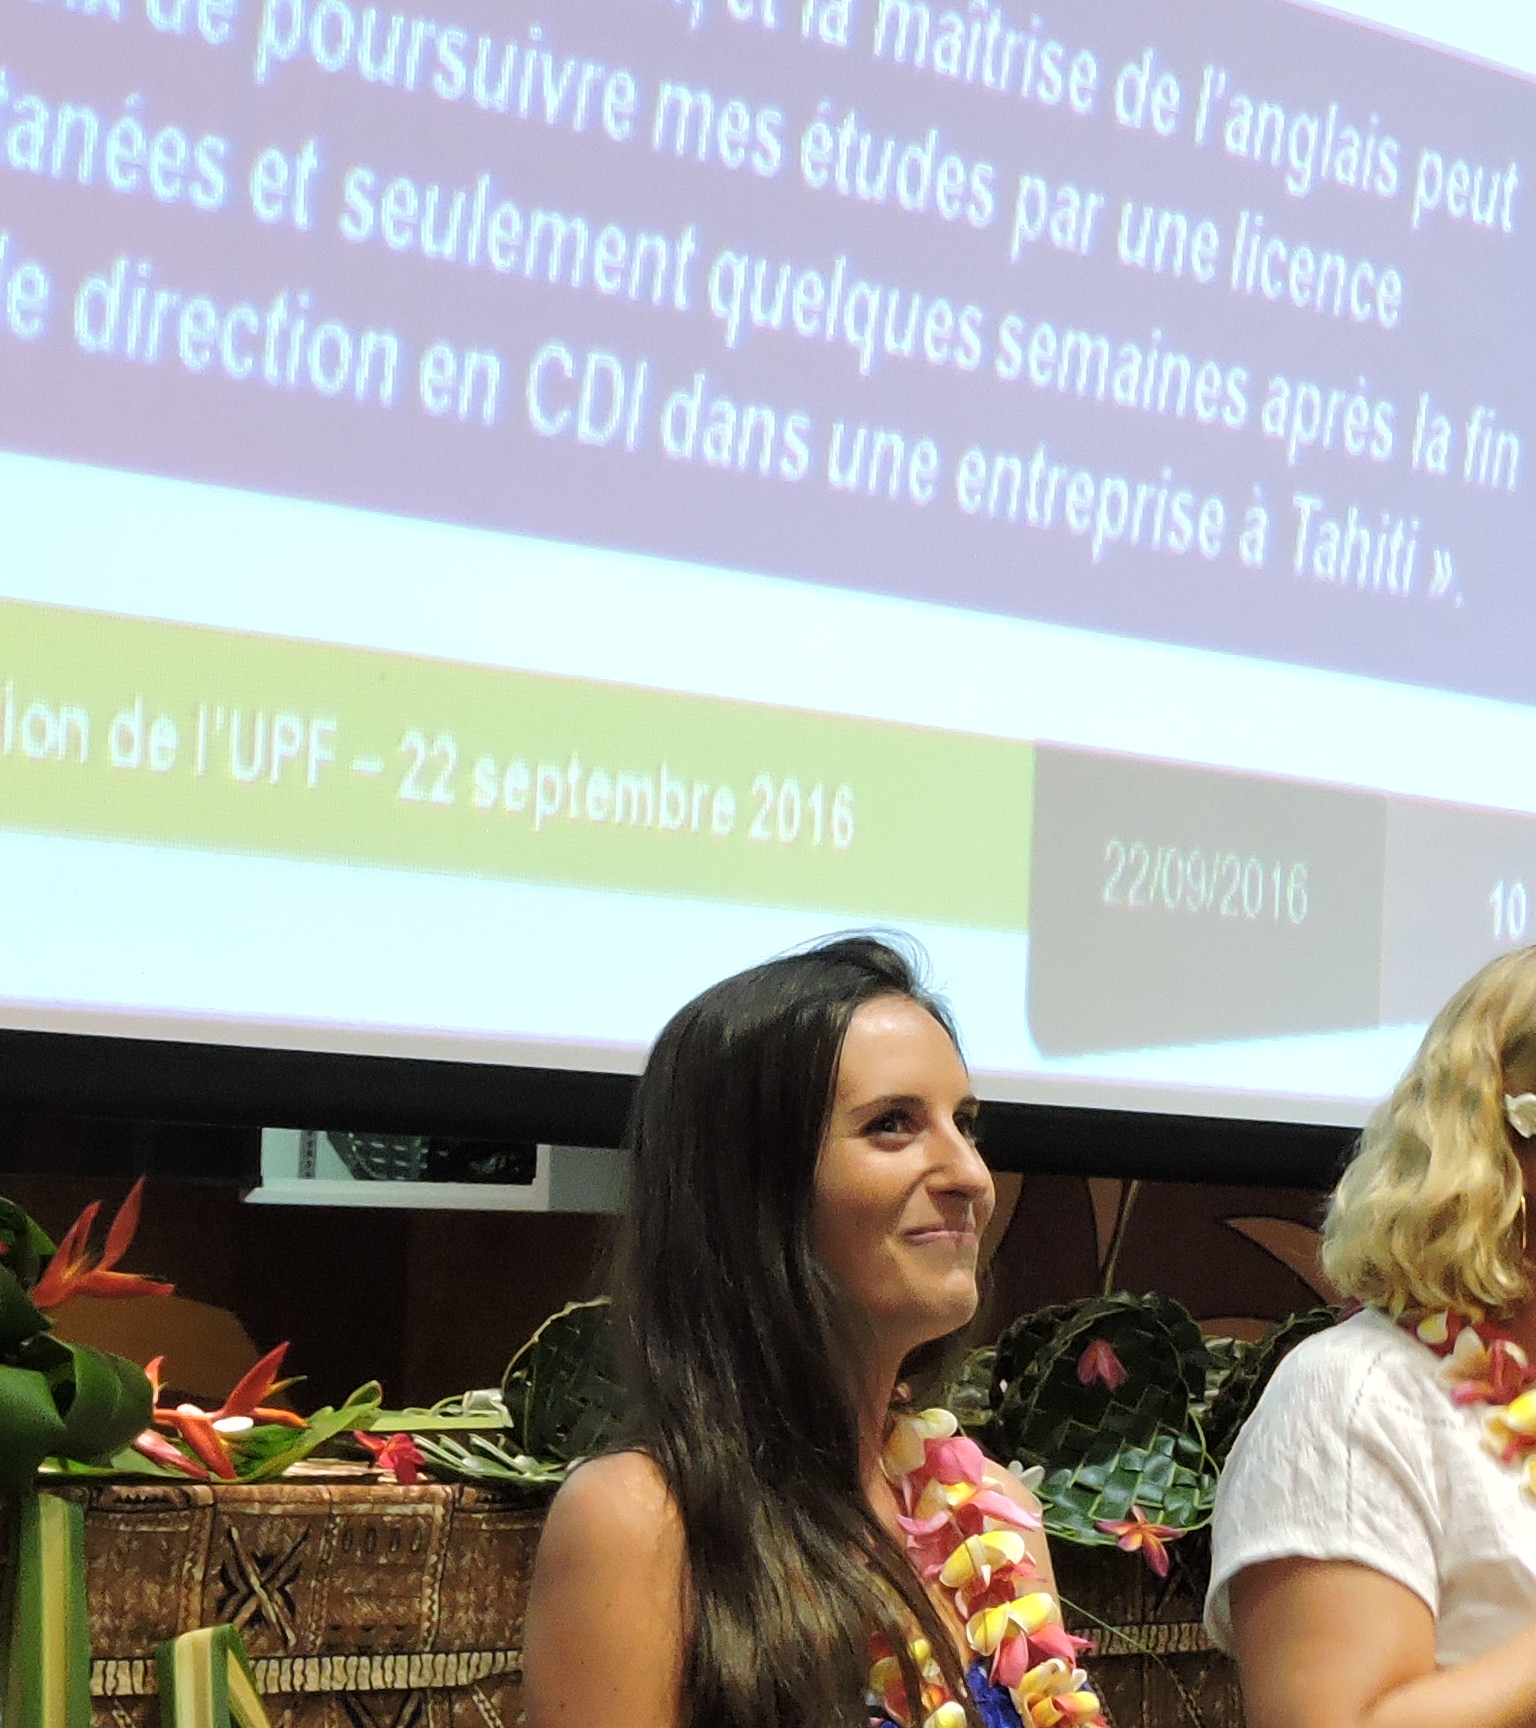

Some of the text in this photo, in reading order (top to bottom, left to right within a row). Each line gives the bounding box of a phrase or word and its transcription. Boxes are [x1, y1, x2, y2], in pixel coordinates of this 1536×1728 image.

[252, 0, 637, 140] poursuivre
[652, 80, 782, 176] mes
[800, 98, 996, 228] études
[1010, 174, 1106, 262] par
[1117, 202, 1221, 284] une
[1230, 210, 1404, 328] licence
[873, 0, 1098, 114] maîtrise
[1114, 46, 1181, 135] de
[1195, 64, 1400, 197] l'anglais
[1412, 148, 1519, 232] peut
[74, 255, 400, 406] direction
[419, 340, 502, 425] en
[526, 340, 648, 452] CDI
[661, 372, 810, 480] dans
[828, 420, 940, 504] une
[954, 443, 1227, 564] entreprise
[1237, 484, 1270, 568] à
[1293, 493, 1419, 597] Tahiti
[250, 137, 318, 231] et
[339, 163, 697, 311] seulement
[707, 249, 984, 376] quelques
[995, 312, 1249, 430] semaines
[1262, 374, 1396, 466] après
[1411, 392, 1451, 478] la
[1465, 405, 1521, 491] fin
[108, 692, 179, 772] de
[196, 703, 339, 788] l'UPF
[399, 730, 459, 806] 22
[472, 752, 737, 838] septembre
[748, 772, 856, 851] 2016
[1102, 838, 1310, 924] 22/09/2016
[1490, 880, 1528, 940] 10
